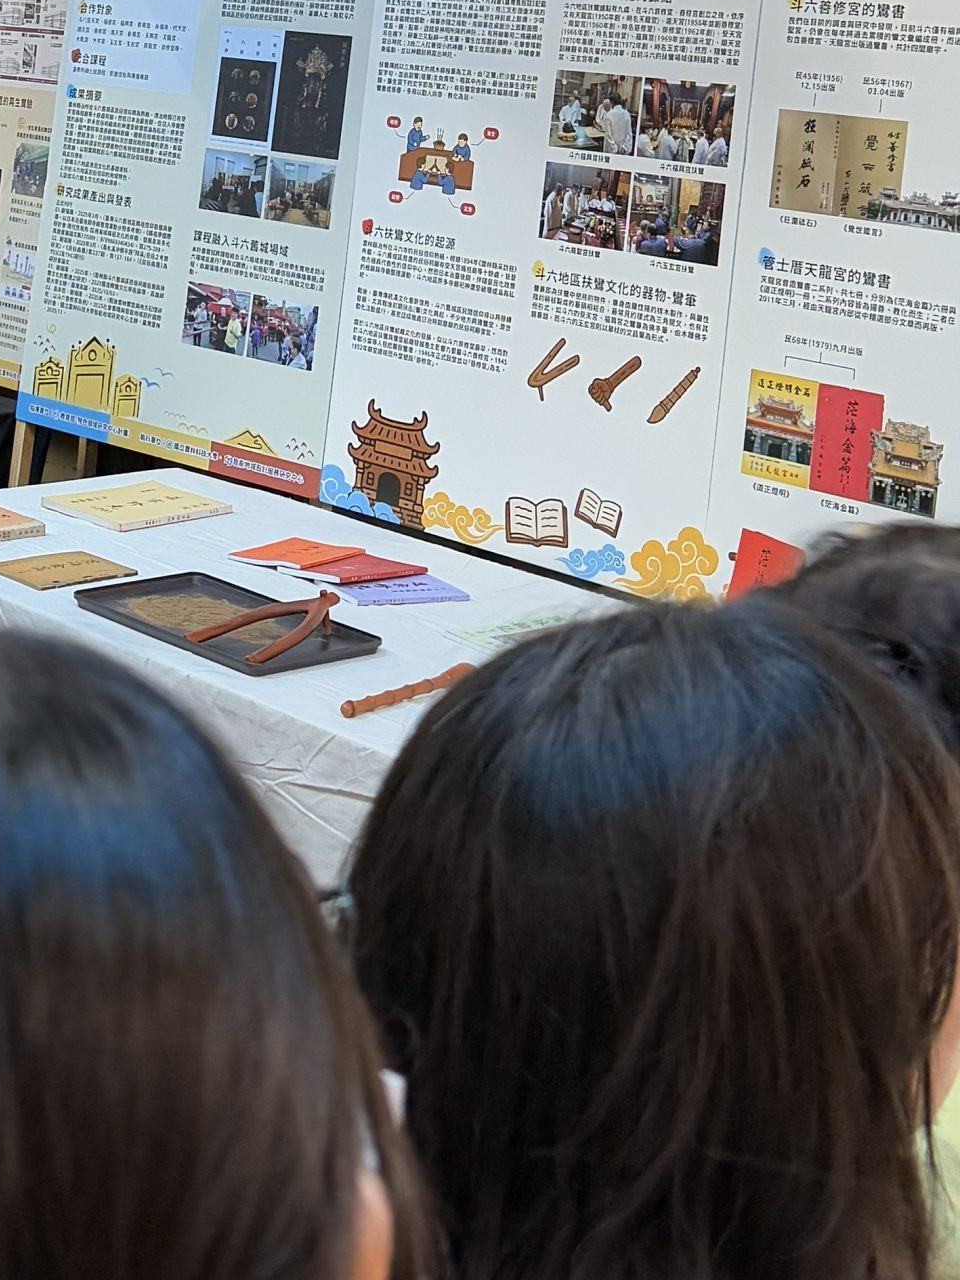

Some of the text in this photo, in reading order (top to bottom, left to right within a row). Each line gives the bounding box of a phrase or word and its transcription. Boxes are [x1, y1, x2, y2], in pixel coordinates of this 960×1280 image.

[790, 0, 906, 19] 斗六善修宮的鸞書
